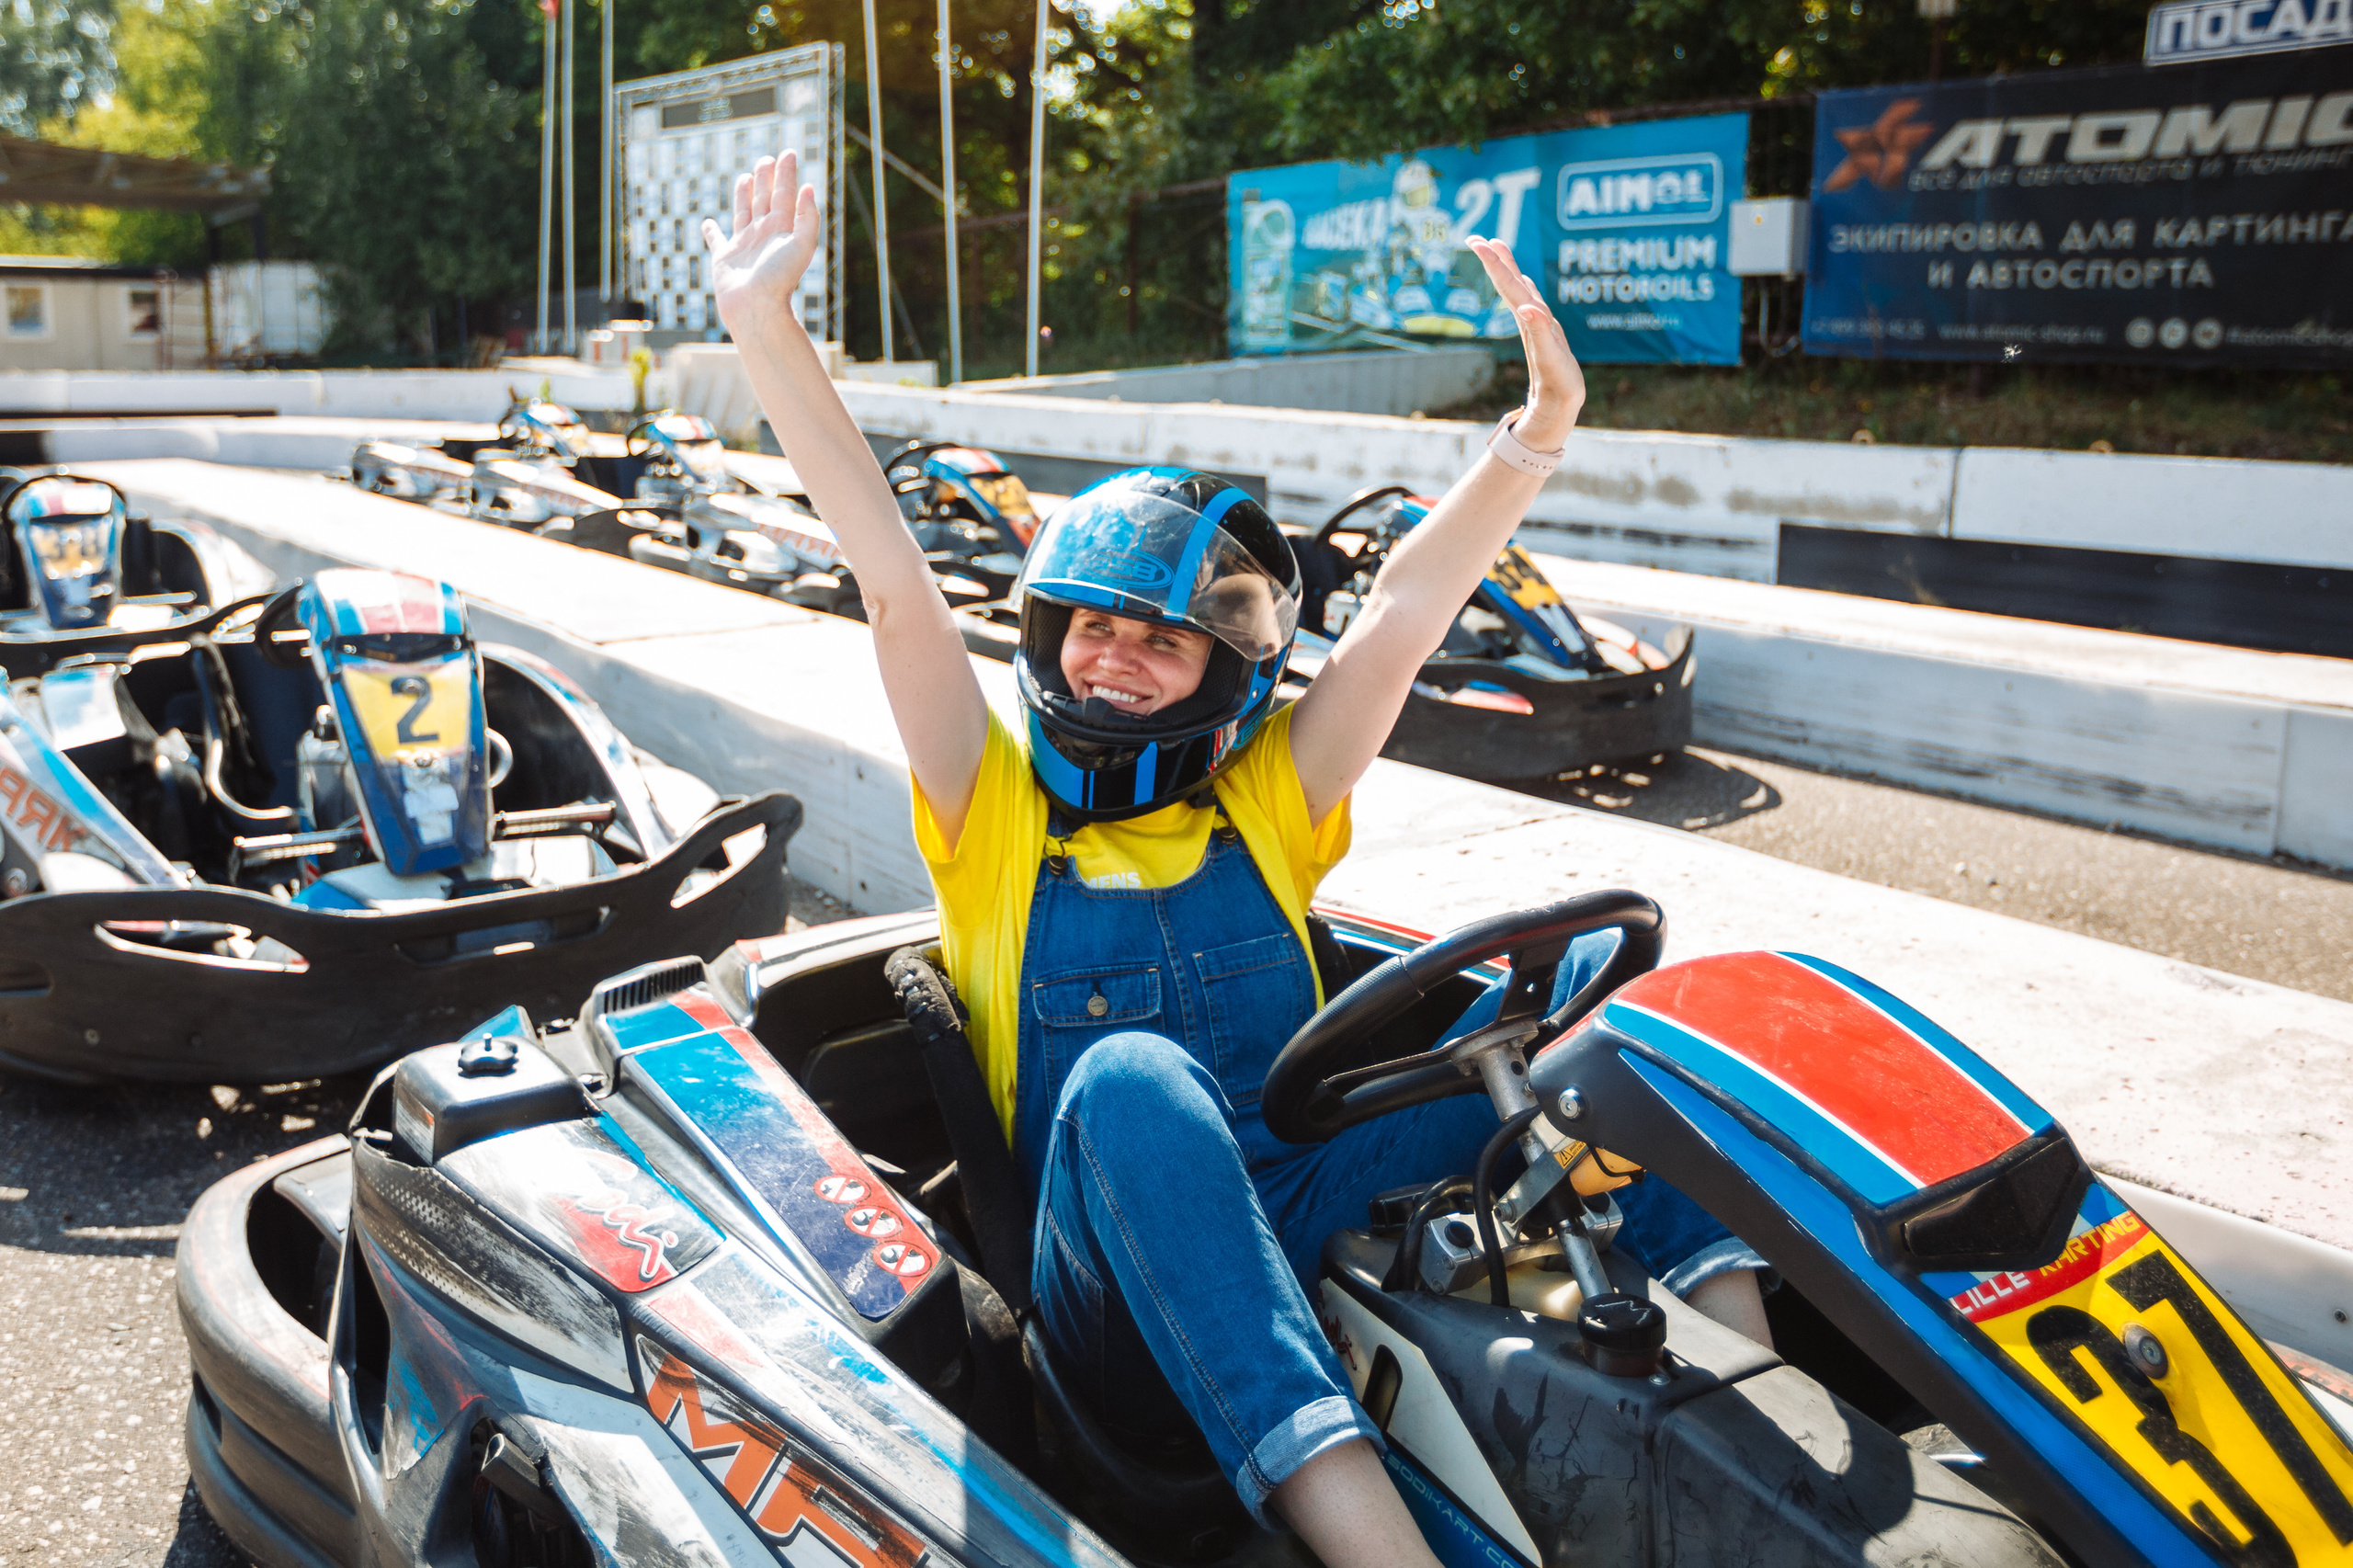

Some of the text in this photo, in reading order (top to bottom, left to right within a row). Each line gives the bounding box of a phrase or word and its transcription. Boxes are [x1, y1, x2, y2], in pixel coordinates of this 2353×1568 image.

[1559, 234, 1717, 274] PREMIUM
[1829, 220, 2043, 254] ЭКИПИРОВКА
[2059, 220, 2136, 253] ДЛЯ
[1558, 274, 1715, 303] MOTOROILS
[1928, 257, 2214, 290] И АВТОСПОРТА
[391, 676, 440, 744] 2
[1948, 1271, 2030, 1314] LILLE
[2026, 1249, 2353, 1568] 37
